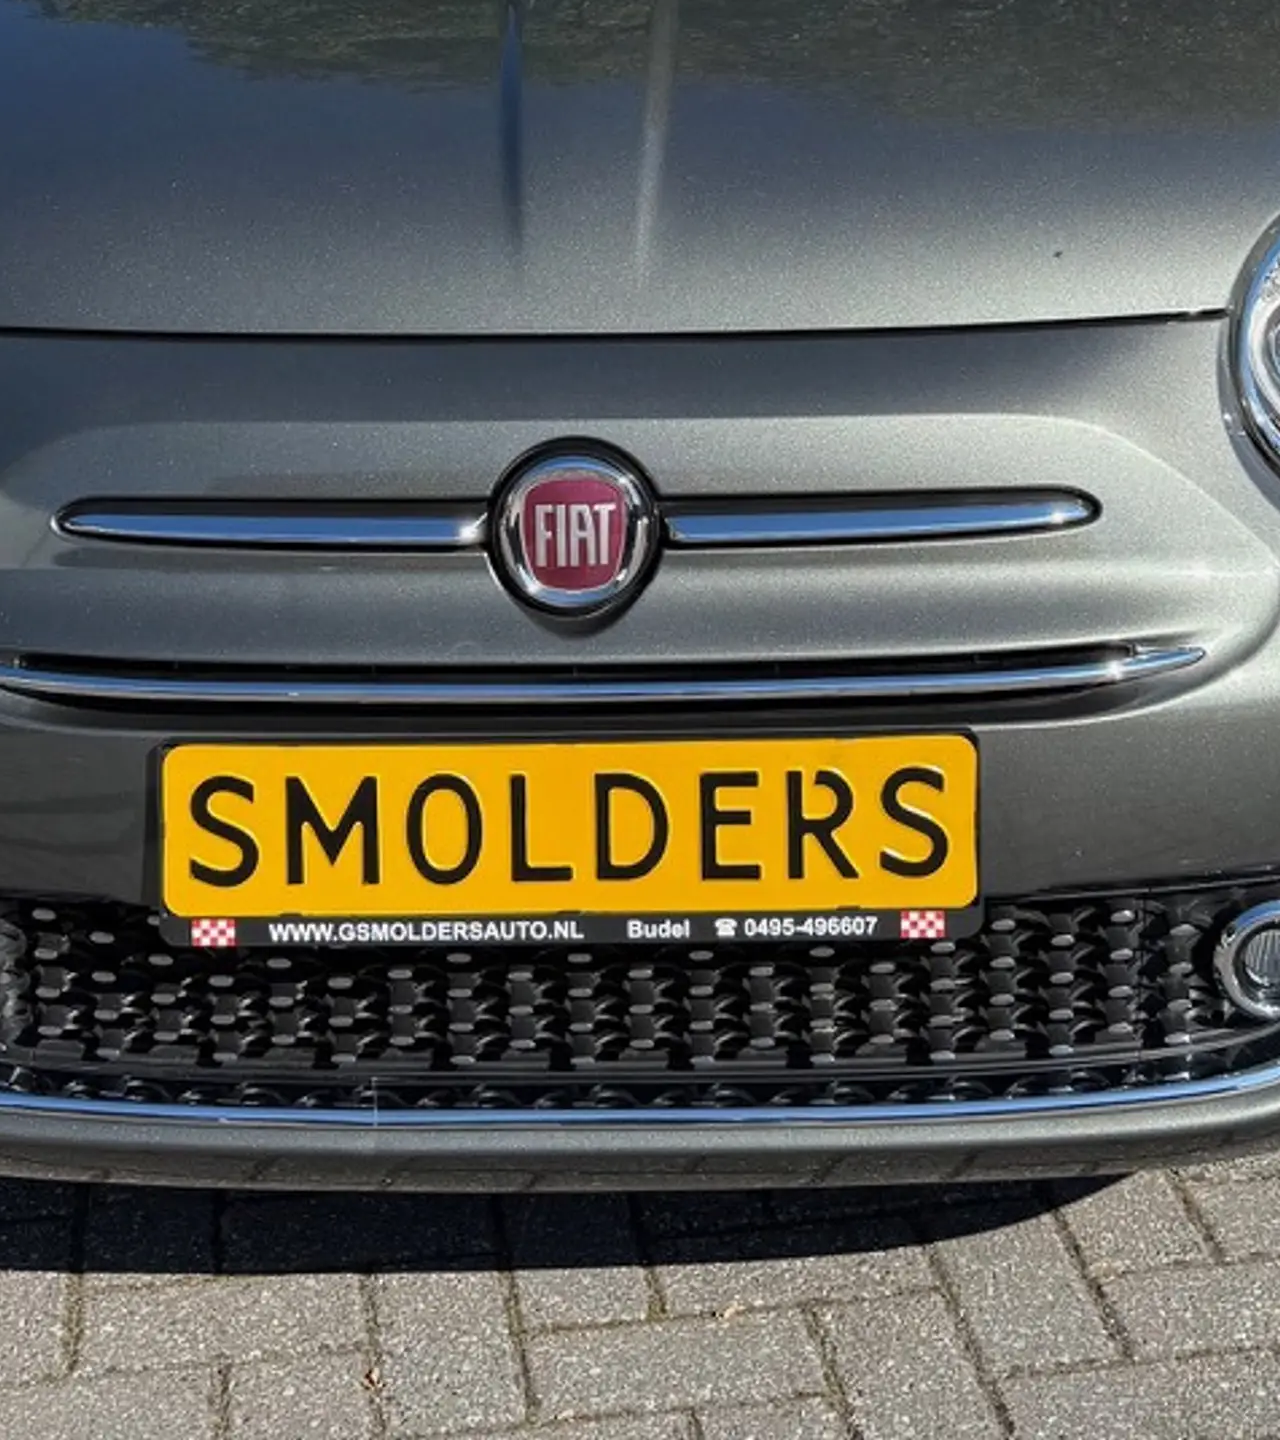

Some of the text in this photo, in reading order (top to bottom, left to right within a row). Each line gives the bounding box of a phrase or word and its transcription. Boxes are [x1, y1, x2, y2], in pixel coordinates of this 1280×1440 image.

[533, 502, 618, 568] FIAT
[187, 766, 950, 888] SMOLDERS
[268, 915, 878, 943] WWW.GSMOLDERSAUTO.NL Budel 0495-496607
